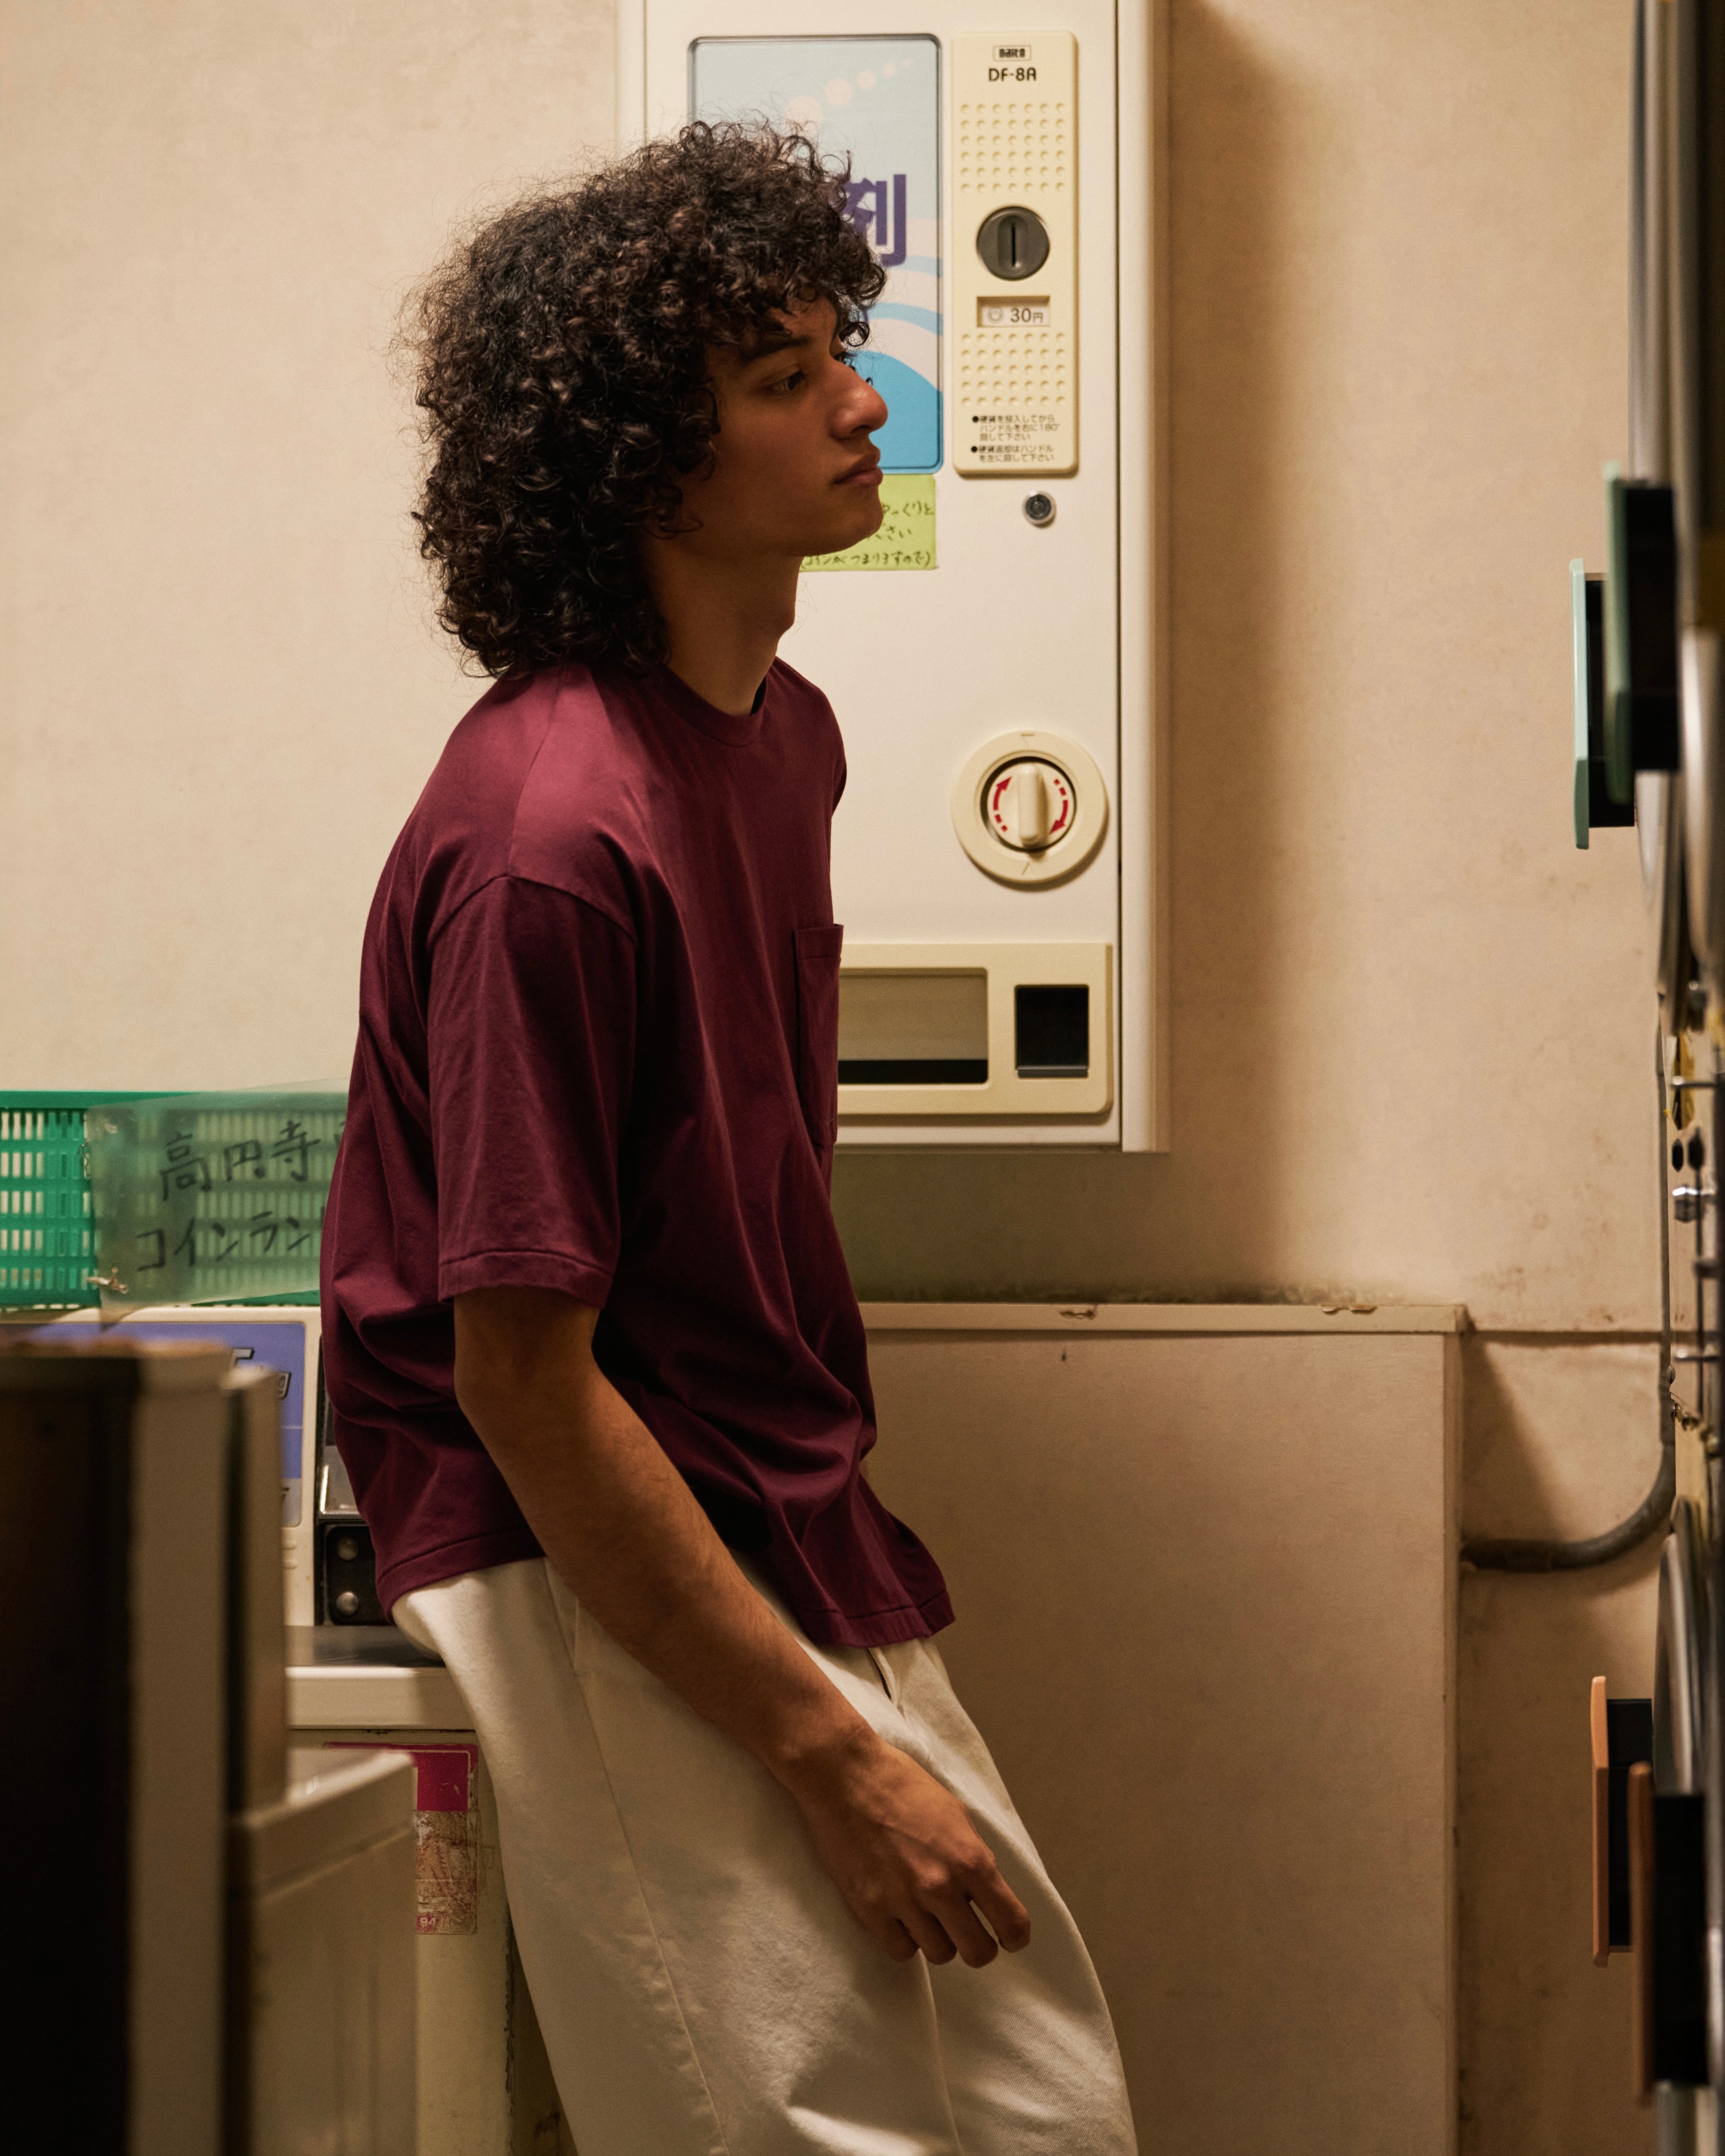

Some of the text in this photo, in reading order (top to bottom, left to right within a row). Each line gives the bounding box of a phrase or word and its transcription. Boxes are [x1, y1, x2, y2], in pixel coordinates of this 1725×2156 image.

[989, 67, 1036, 81] DF-8A
[1010, 308, 1043, 322] 30円
[159, 1120, 347, 1201] 高円寺
[136, 1207, 326, 1271] コインラン
